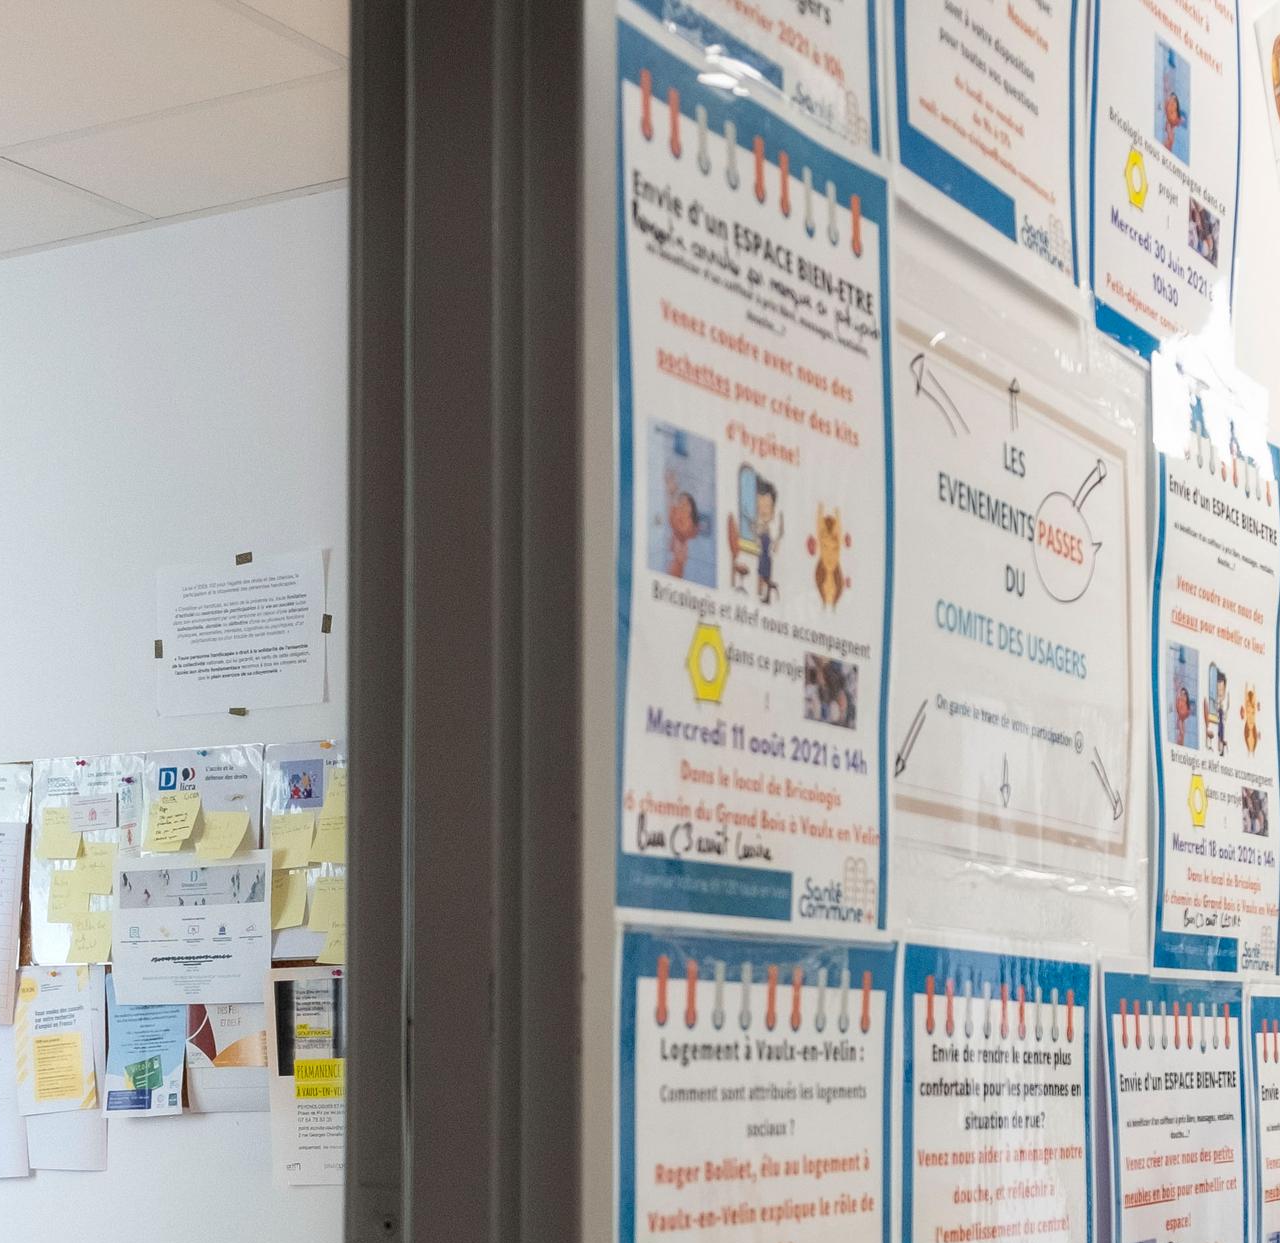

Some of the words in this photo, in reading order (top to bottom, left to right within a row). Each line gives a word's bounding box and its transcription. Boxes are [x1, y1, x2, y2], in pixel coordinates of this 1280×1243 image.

[632, 169, 683, 219] Envie
[688, 198, 728, 241] d'un
[733, 222, 793, 275] ESPACE
[797, 255, 874, 316] BIEN-ETRE
[1111, 206, 1152, 253] Mercredi
[1155, 240, 1166, 264] 30
[1167, 251, 1185, 280] Juin
[1187, 266, 1208, 297] 2021
[1152, 273, 1179, 307] 10h30
[660, 298, 707, 338] Venez
[1004, 441, 1026, 478] LES
[937, 471, 1035, 543] EVENEMENTS
[1038, 519, 1084, 566] PASSES
[1169, 474, 1191, 499] Envie
[1193, 487, 1210, 511] d'un
[1212, 497, 1240, 527] ESPACE
[1241, 513, 1278, 546] BIEN-ETRE
[1005, 563, 1026, 598] DU
[935, 598, 994, 648] COMITE
[998, 621, 1024, 658] DES
[1029, 633, 1088, 680] USAGERS
[646, 705, 727, 746] Mercredi
[732, 724, 745, 750] 11
[750, 732, 786, 759] août
[791, 736, 828, 766] 2021
[845, 751, 868, 775] 14h
[1172, 832, 1207, 857] Mercredi
[1218, 842, 1236, 862] août
[1238, 845, 1256, 866] 2021
[1263, 850, 1275, 868] 14h
[804, 876, 842, 903] Santé
[799, 896, 863, 923] Commune
[660, 1037, 740, 1068] Logement
[744, 1035, 752, 1063] à
[932, 1043, 960, 1063] Envie
[963, 1044, 975, 1063] de
[1012, 1045, 1020, 1064] le
[1023, 1049, 1052, 1066] centre
[1053, 1047, 1072, 1070] plus
[655, 1163, 700, 1190] Roger
[760, 1154, 781, 1179] élu
[784, 1158, 800, 1177] au
[803, 1153, 860, 1181] logement
